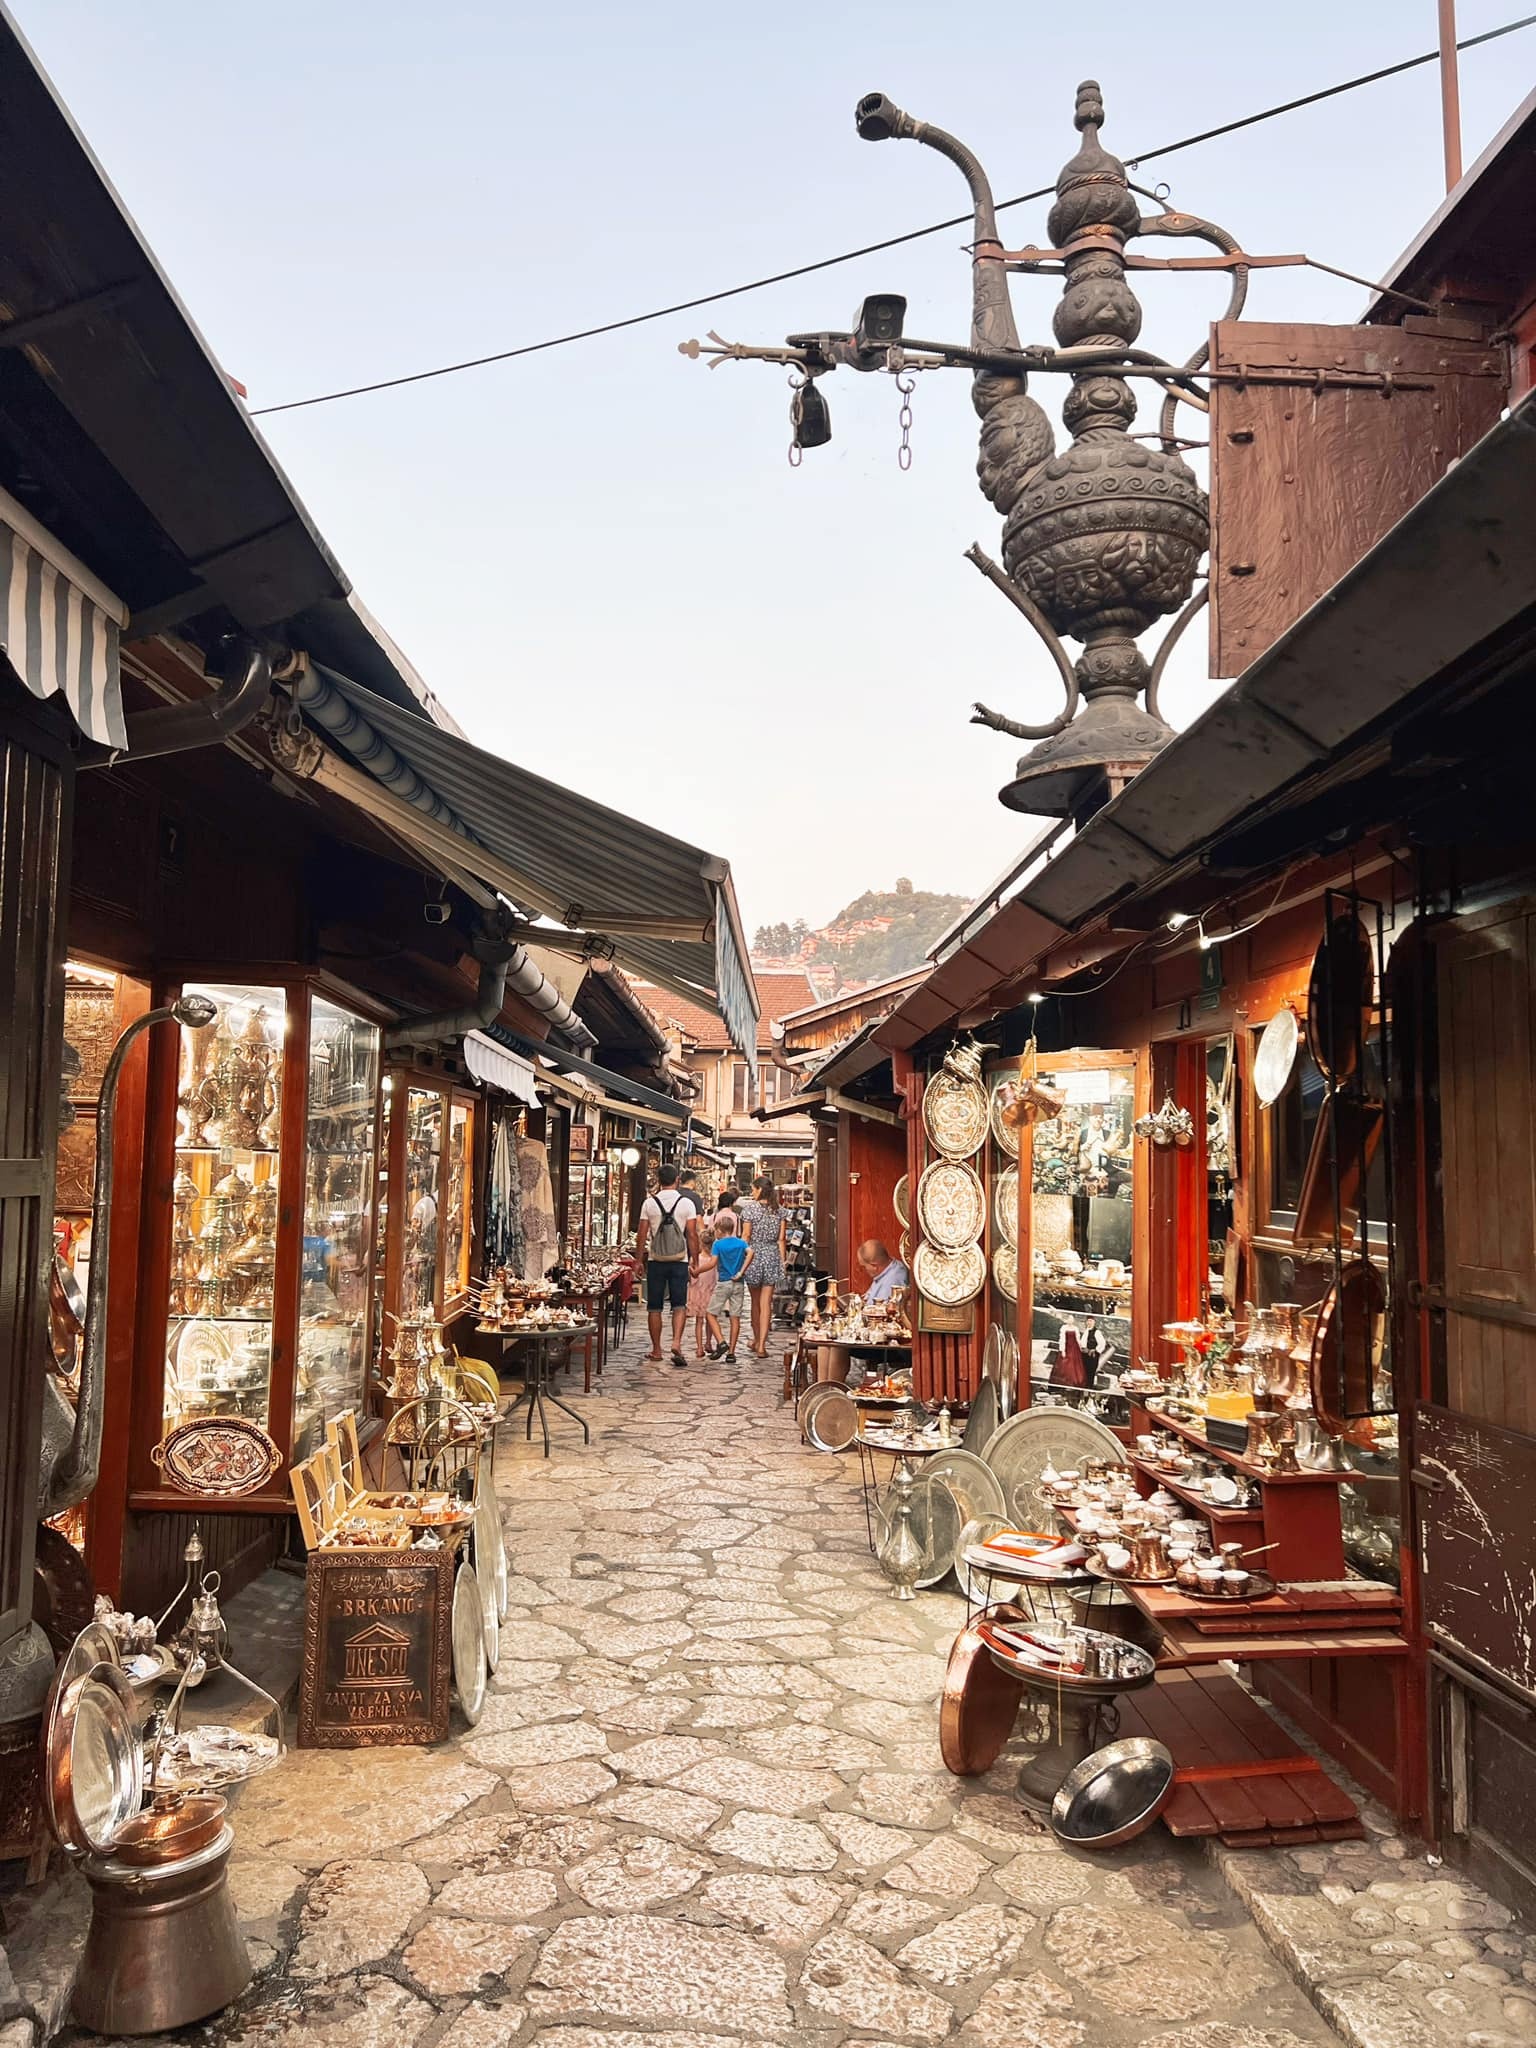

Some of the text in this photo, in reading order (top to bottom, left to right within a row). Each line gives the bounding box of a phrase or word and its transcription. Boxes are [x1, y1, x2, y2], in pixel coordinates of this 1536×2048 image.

[345, 1646, 408, 1677] UNESCO
[325, 1689, 424, 1706] ZANAT ZA SVA
[348, 1704, 408, 1719] VREMENA
